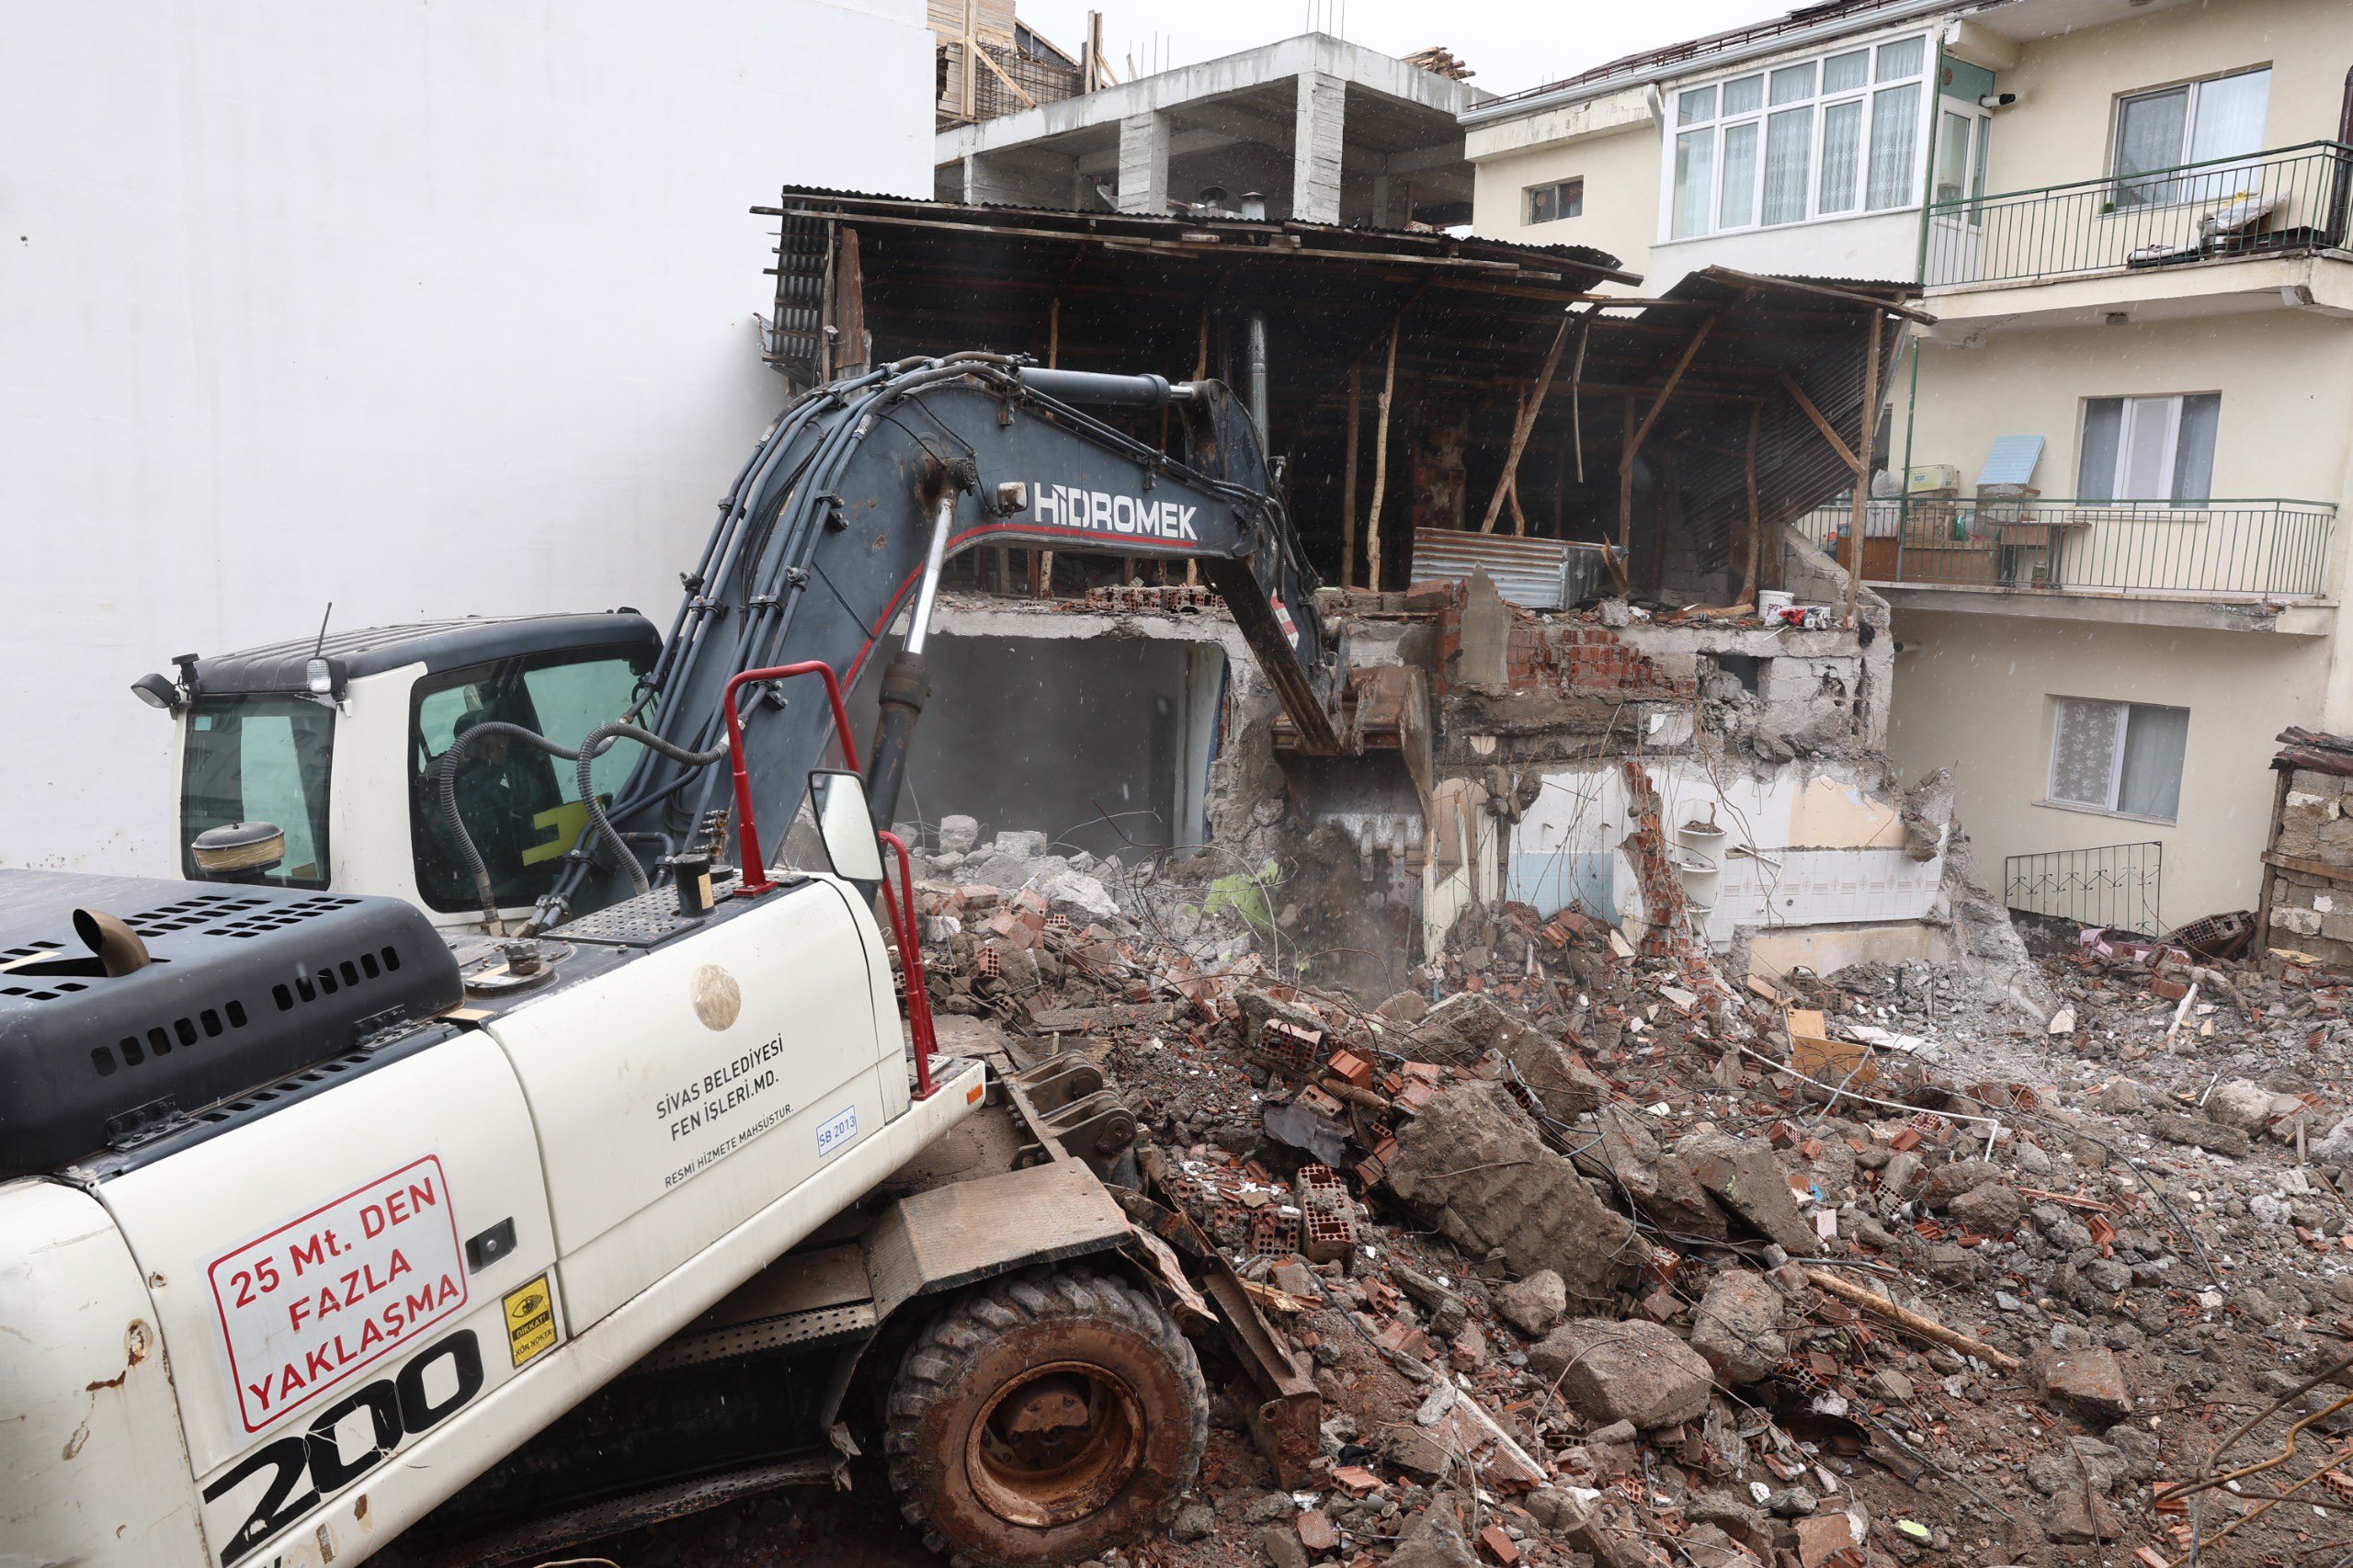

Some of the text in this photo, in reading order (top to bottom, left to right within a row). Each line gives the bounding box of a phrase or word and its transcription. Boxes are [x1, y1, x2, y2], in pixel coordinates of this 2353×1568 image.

[656, 1033, 783, 1119] SİVAS BELEDİYESİ
[671, 1111, 701, 1142] FEN
[697, 1137, 737, 1170] HİZMETE
[819, 1115, 856, 1147] SB 2013
[230, 1176, 437, 1309] 25 Mt. DEN
[288, 1248, 413, 1333] FAZLA
[248, 1273, 460, 1411] YAKLAŞMA
[530, 1329, 552, 1346] NOKTA
[201, 1328, 484, 1568] 200
